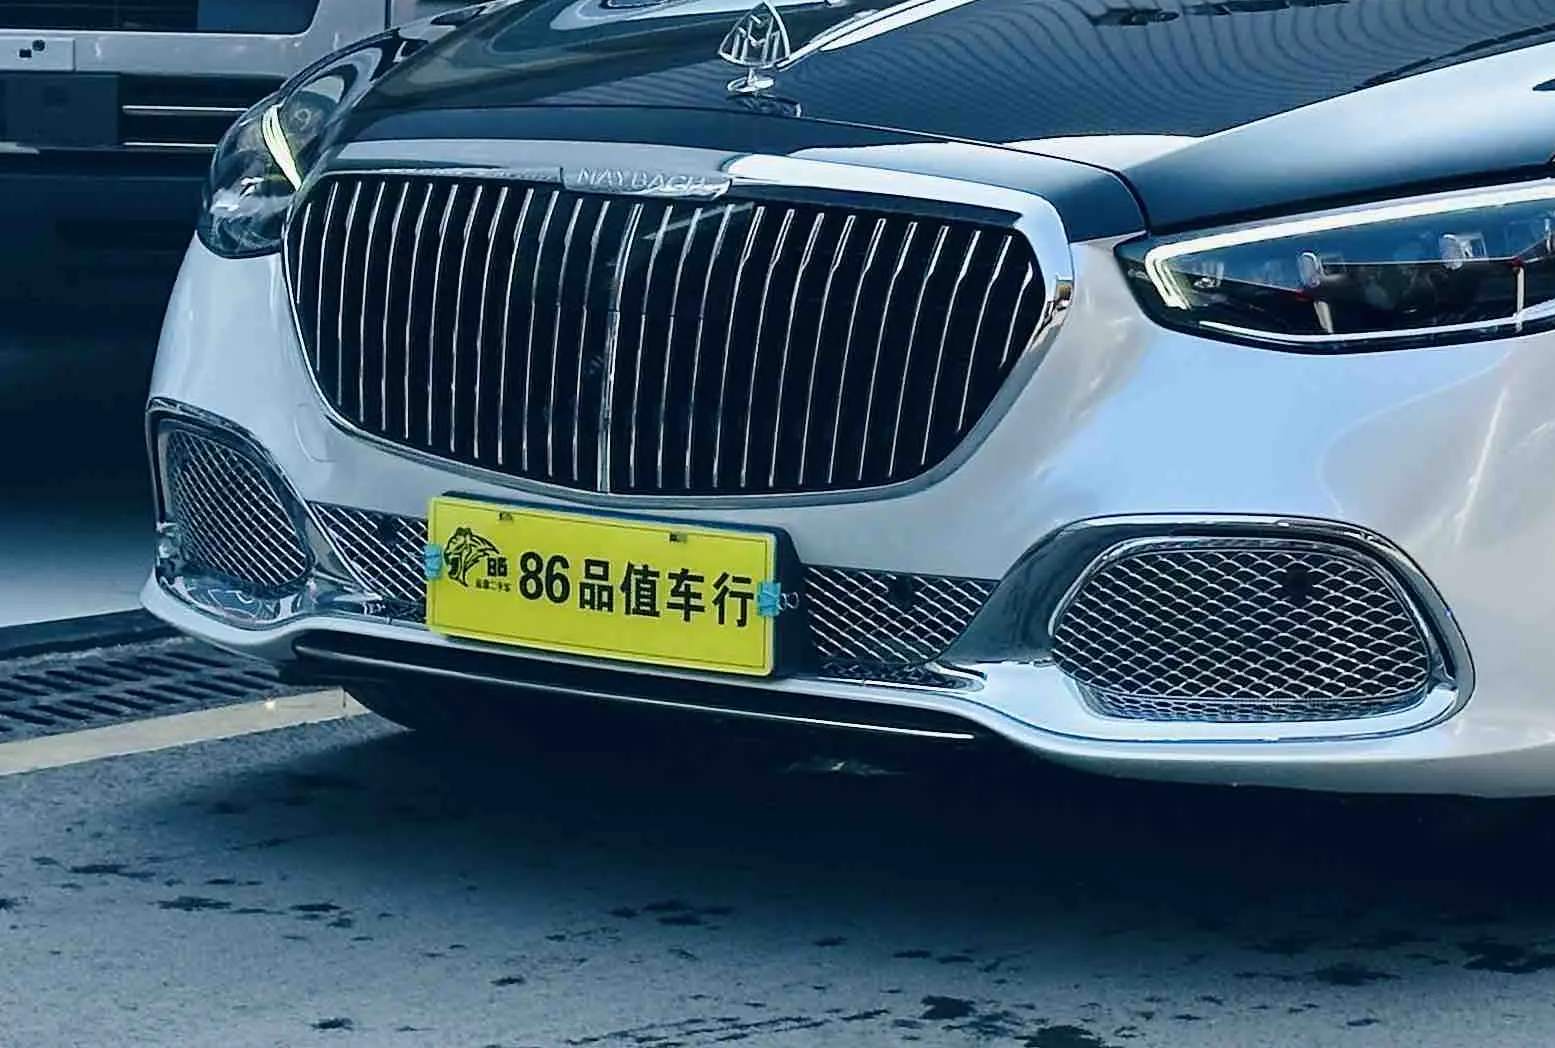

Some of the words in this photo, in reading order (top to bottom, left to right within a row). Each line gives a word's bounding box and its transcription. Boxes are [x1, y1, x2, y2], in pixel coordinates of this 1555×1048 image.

[576, 166, 708, 193] MAYBACH
[487, 556, 508, 577] 86
[519, 551, 755, 628] 86品值车行
